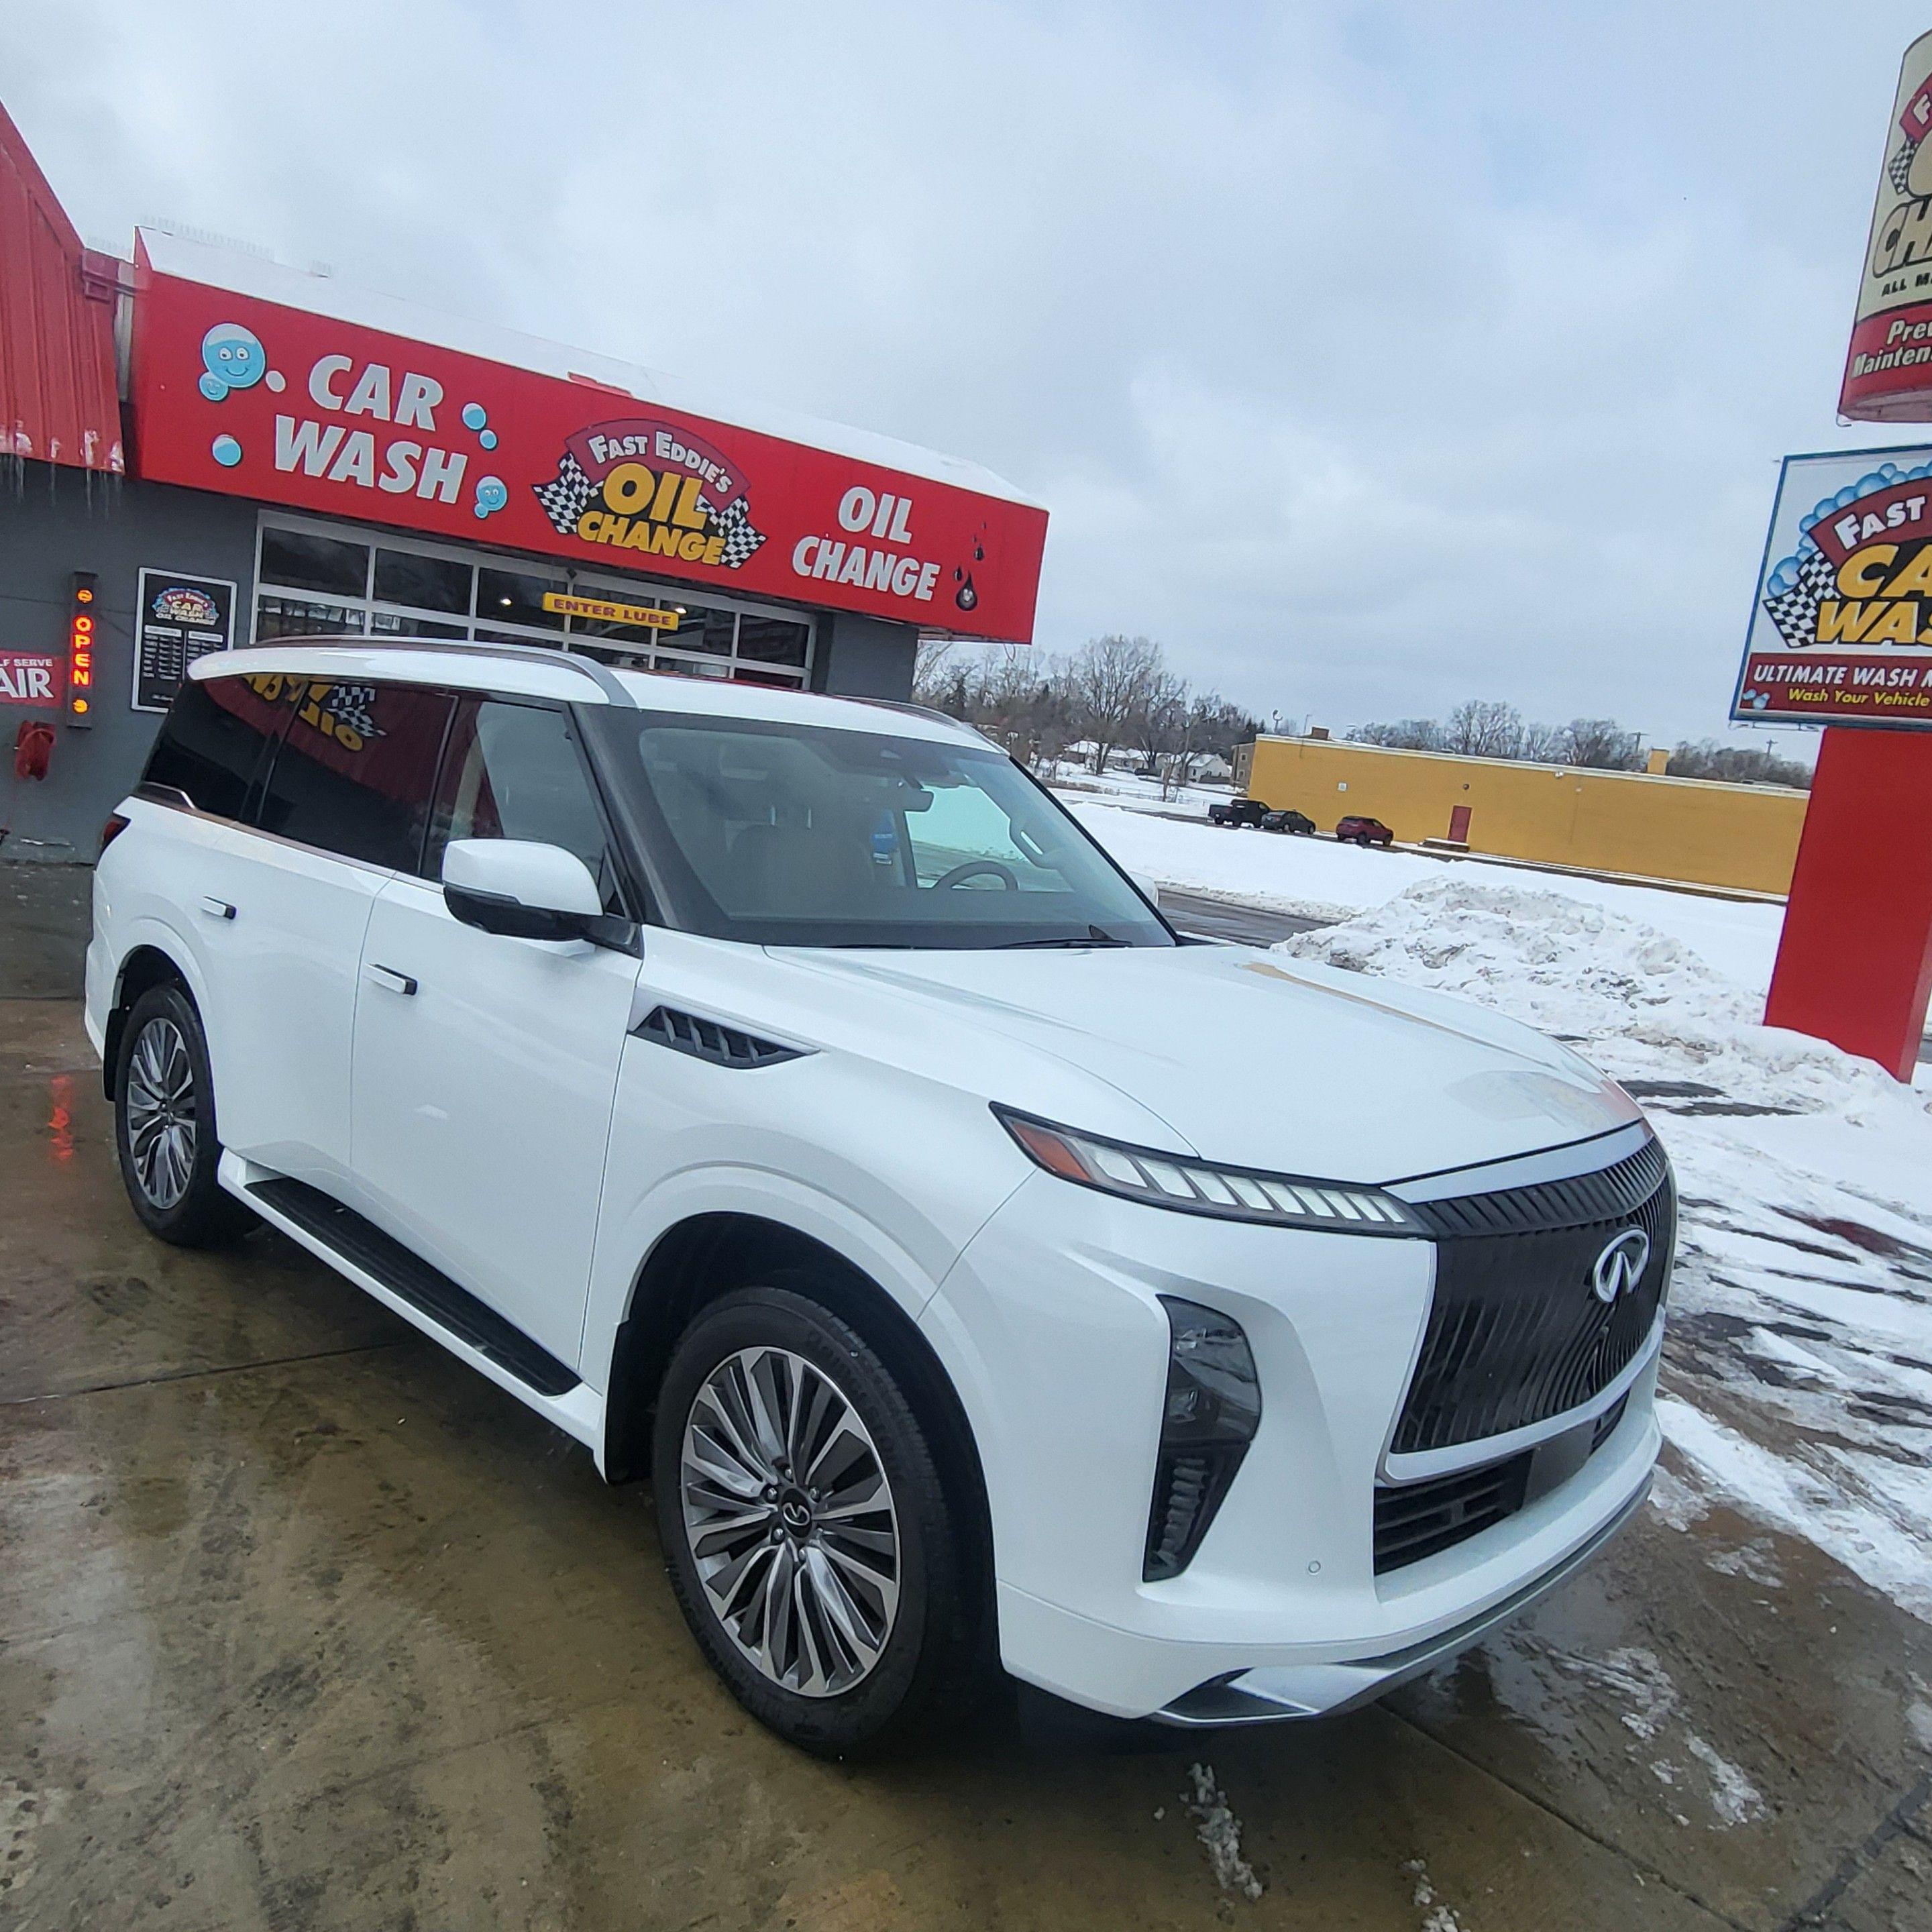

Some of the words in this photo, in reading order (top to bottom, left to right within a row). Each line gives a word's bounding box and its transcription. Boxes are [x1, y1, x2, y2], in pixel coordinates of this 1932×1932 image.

[1873, 198, 1932, 276] CH
[1882, 278, 1907, 297] ALL
[1851, 346, 1932, 378] Mainten
[309, 354, 443, 431] CAR
[275, 414, 468, 504] WASH
[588, 435, 648, 464] FAST
[655, 431, 733, 493] EDDIE'S
[603, 463, 708, 530] OIL
[839, 486, 912, 543] OIL
[1834, 496, 1925, 550] FAST
[577, 511, 727, 566] CHANGE
[792, 536, 941, 600] CHANGE
[554, 598, 616, 616] ENTER
[623, 609, 671, 625] LUBE
[13, 659, 53, 667] SERVE
[72, 616, 93, 686] OPEN
[1754, 665, 1847, 684] ULTIMATE
[1853, 667, 1918, 688] WASH
[1788, 688, 1828, 702] Wash
[1834, 691, 1869, 704] Your
[1874, 692, 1930, 707] Vehicle
